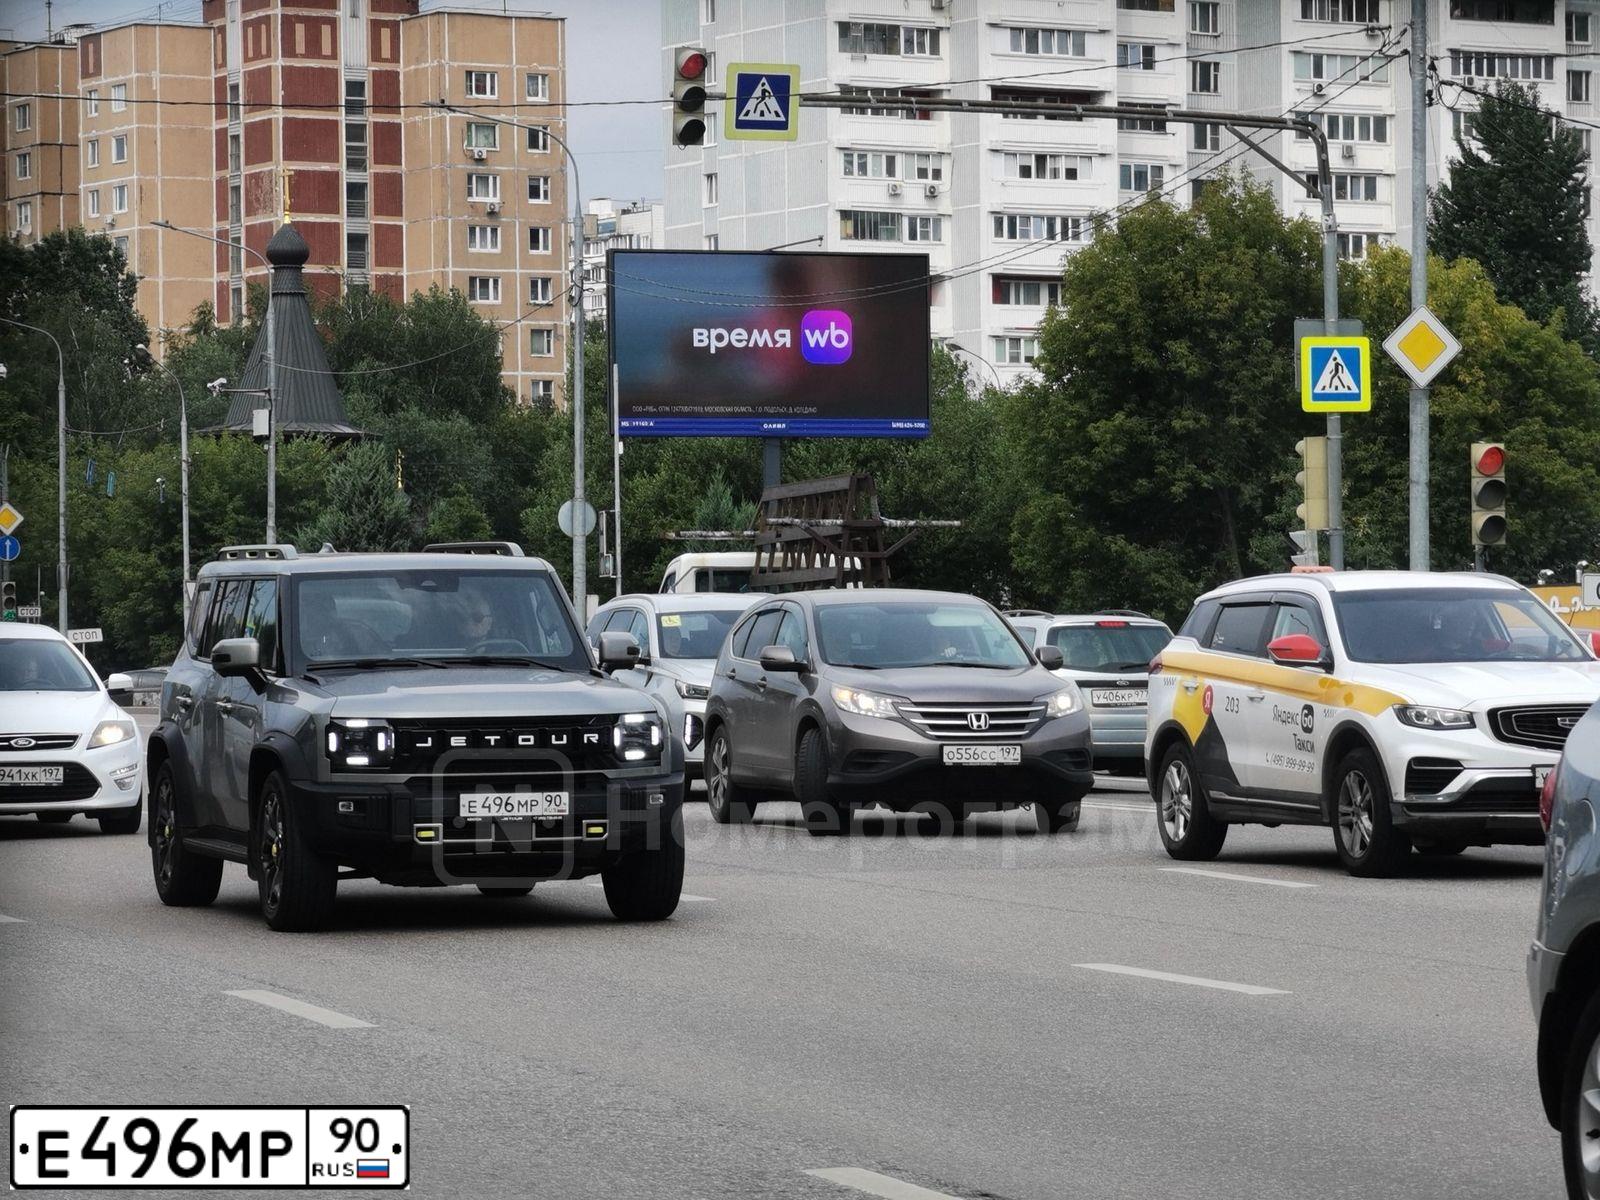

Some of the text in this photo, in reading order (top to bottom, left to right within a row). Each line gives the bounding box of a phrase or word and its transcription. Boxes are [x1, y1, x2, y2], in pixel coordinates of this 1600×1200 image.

[693, 328, 791, 354] время
[804, 321, 849, 349] wb
[20, 608, 39, 616] СТОП
[72, 630, 98, 641] СТОП
[1096, 688, 1132, 702] У406КР
[1225, 696, 1240, 714] 203
[1272, 704, 1300, 726] Яндекс
[1302, 709, 1314, 728] Go
[416, 734, 599, 747] JETOUR
[1293, 733, 1315, 753] Такси
[947, 745, 1017, 760] О556СС 197
[42, 768, 60, 778] 197
[468, 795, 562, 813] Е496МР 90
